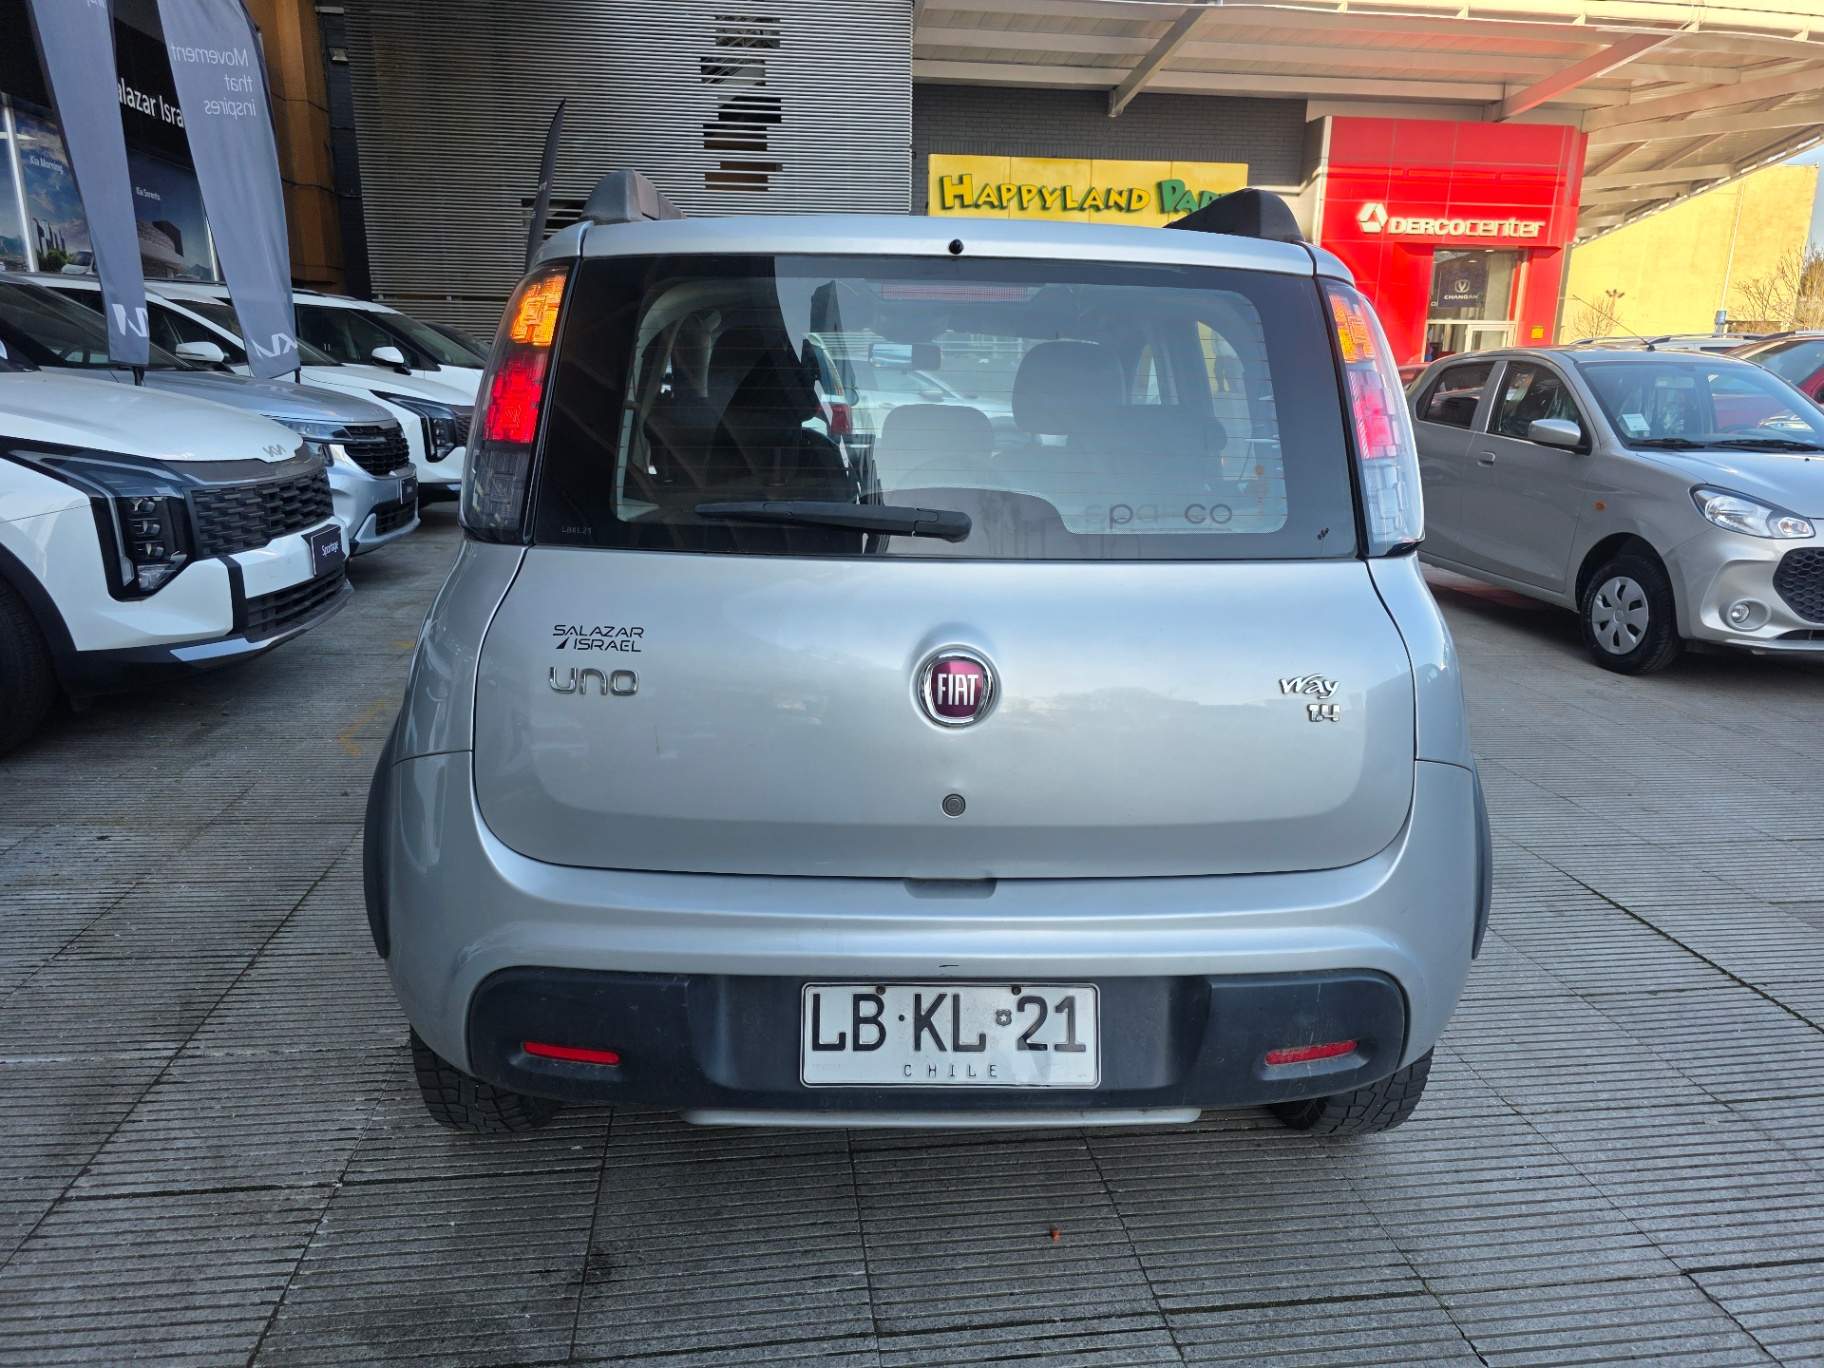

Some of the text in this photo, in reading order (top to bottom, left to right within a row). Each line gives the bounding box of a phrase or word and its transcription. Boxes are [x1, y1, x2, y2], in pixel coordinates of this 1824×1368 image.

[117, 77, 184, 128] alazar Isra
[939, 173, 1232, 214] HAPPYLAND PAR
[552, 624, 645, 639] SALAZAR
[573, 637, 642, 653] ISRAEL
[937, 672, 979, 706] FIAT
[903, 1064, 998, 1078] CHILE
